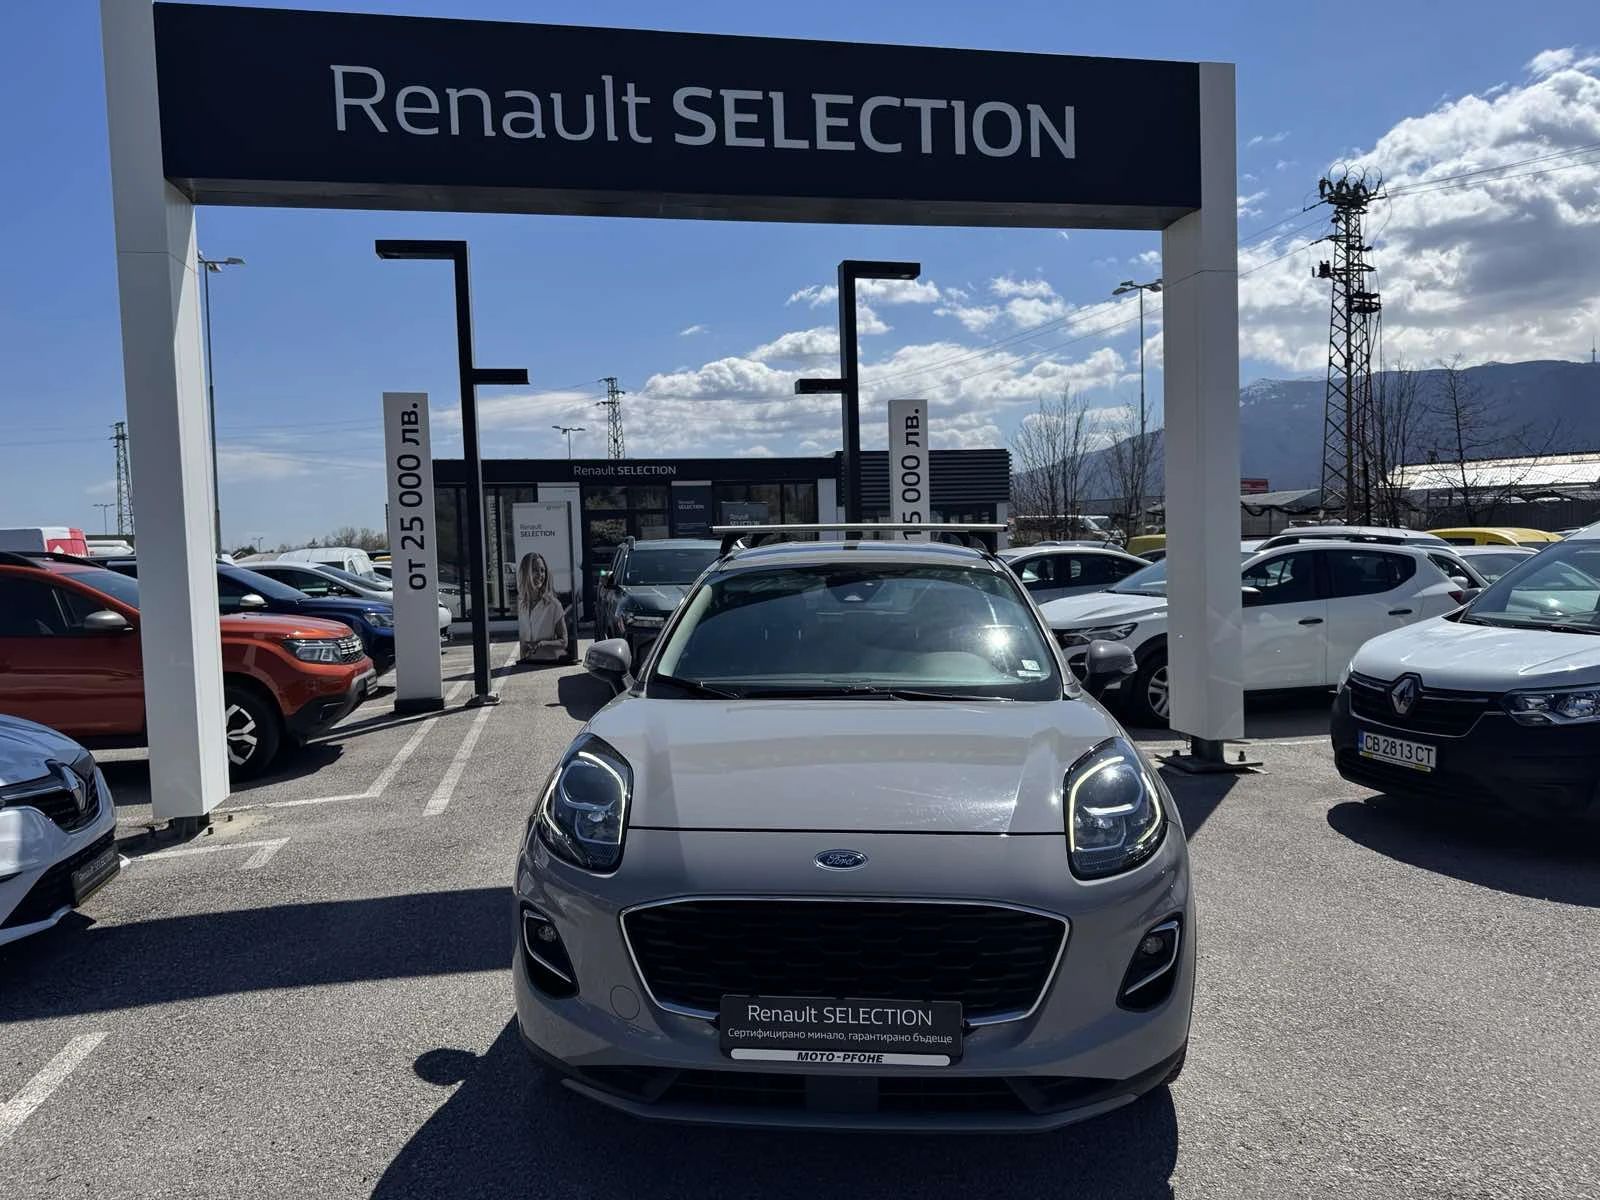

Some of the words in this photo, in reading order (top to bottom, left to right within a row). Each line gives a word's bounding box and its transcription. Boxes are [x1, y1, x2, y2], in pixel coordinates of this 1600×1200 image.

[330, 63, 653, 145] Renault
[672, 85, 1077, 160] SELECTION
[401, 402, 420, 446] лв.
[905, 408, 920, 448] лв.
[396, 453, 423, 508] 000
[573, 464, 615, 476] Renault
[618, 465, 677, 475] SELECTION
[901, 454, 921, 503] 000
[400, 516, 425, 551] 25
[408, 558, 427, 591] от
[1365, 735, 1380, 752] CB
[1382, 739, 1413, 760] 2813
[1415, 746, 1433, 765] CT
[826, 853, 857, 866] Ford
[748, 1005, 818, 1025] Renault
[823, 1007, 932, 1026] SELECTION
[728, 1027, 806, 1040] Сертифицирано
[807, 1030, 847, 1041] минало,
[848, 1032, 911, 1044] гарантирано
[912, 1032, 953, 1045] бъдеще
